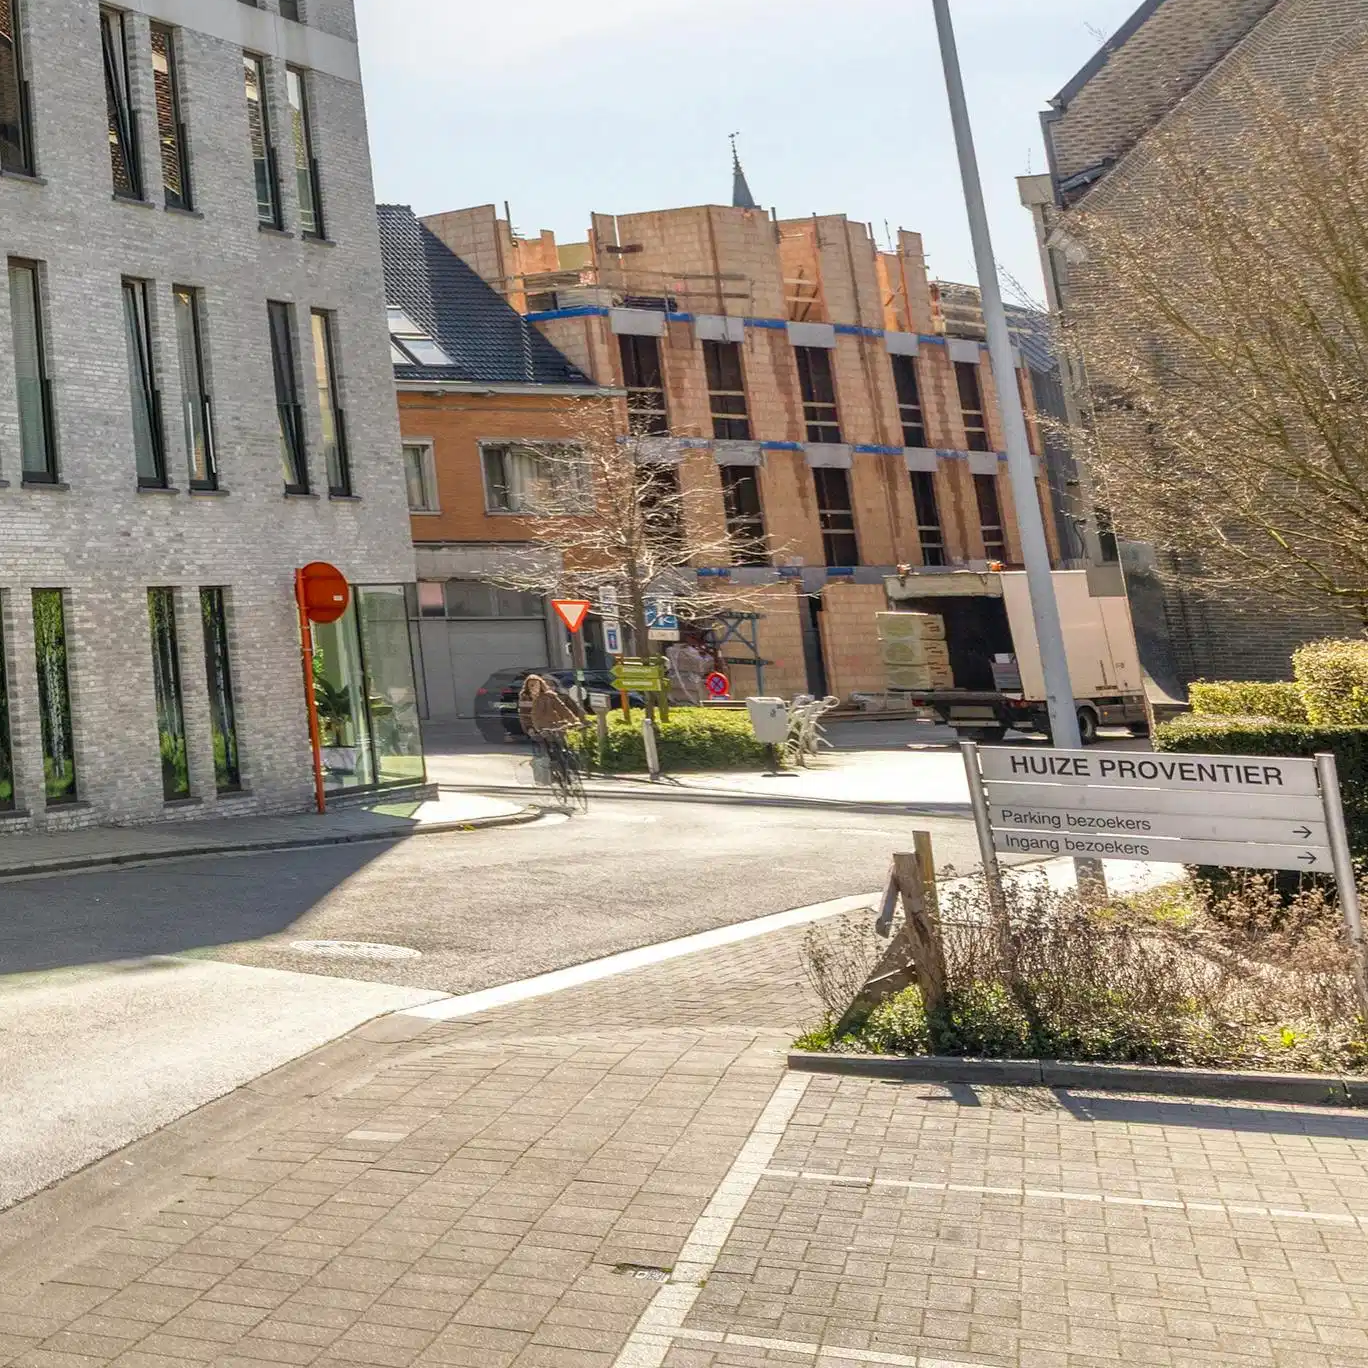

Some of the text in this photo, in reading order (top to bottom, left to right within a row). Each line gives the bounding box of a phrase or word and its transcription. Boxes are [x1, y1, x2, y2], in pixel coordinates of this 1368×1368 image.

[1010, 756, 1284, 785] HUIZE PROVENTIER
[1001, 809, 1152, 831] Parking bezoekers
[1005, 834, 1150, 856] Ingang bezoekers
